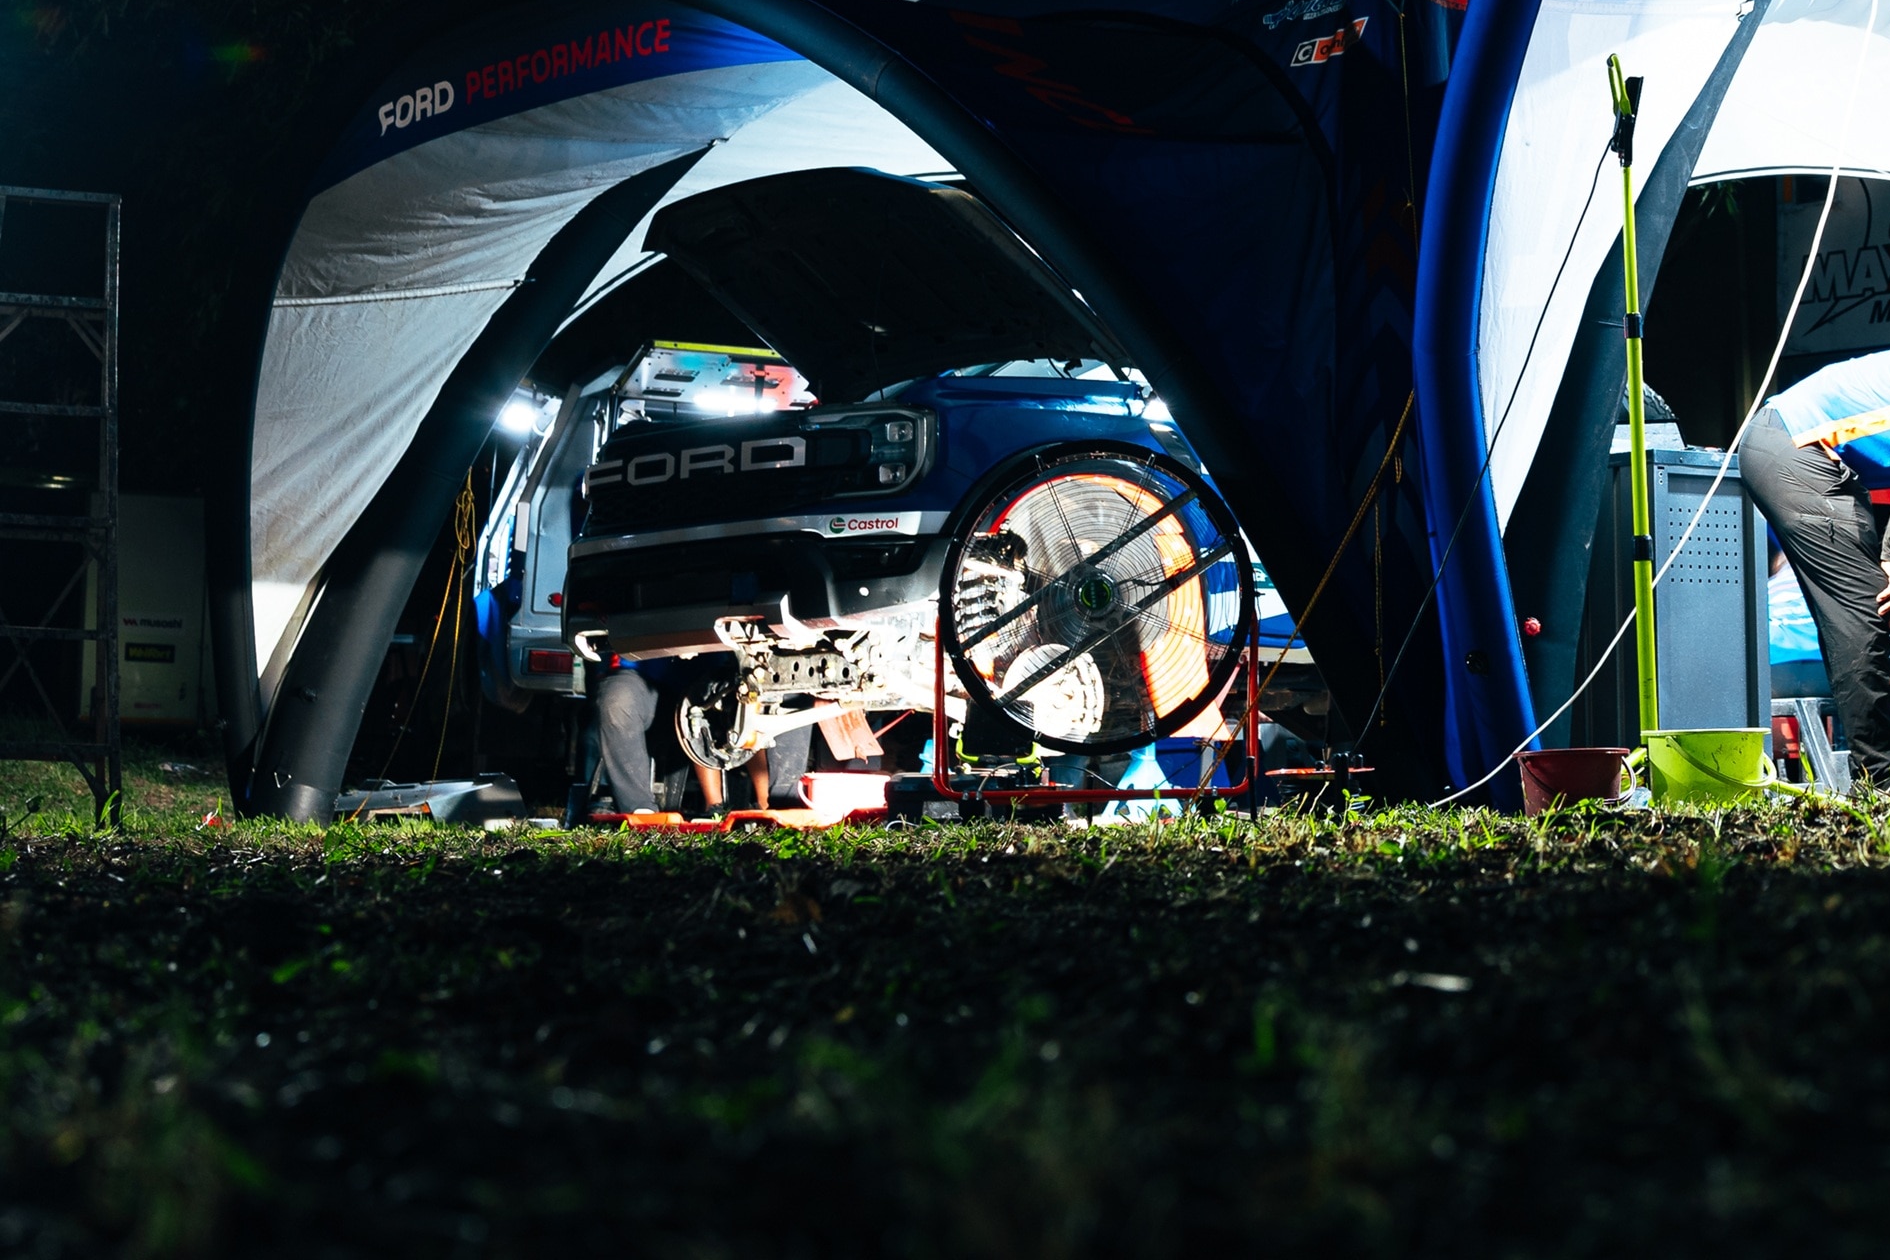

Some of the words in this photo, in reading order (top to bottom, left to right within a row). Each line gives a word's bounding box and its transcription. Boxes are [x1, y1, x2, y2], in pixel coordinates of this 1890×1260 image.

[378, 80, 456, 137] FORD
[464, 18, 672, 106] PERFORMANCE
[584, 436, 807, 487] FORD
[847, 517, 899, 532] Castrol
